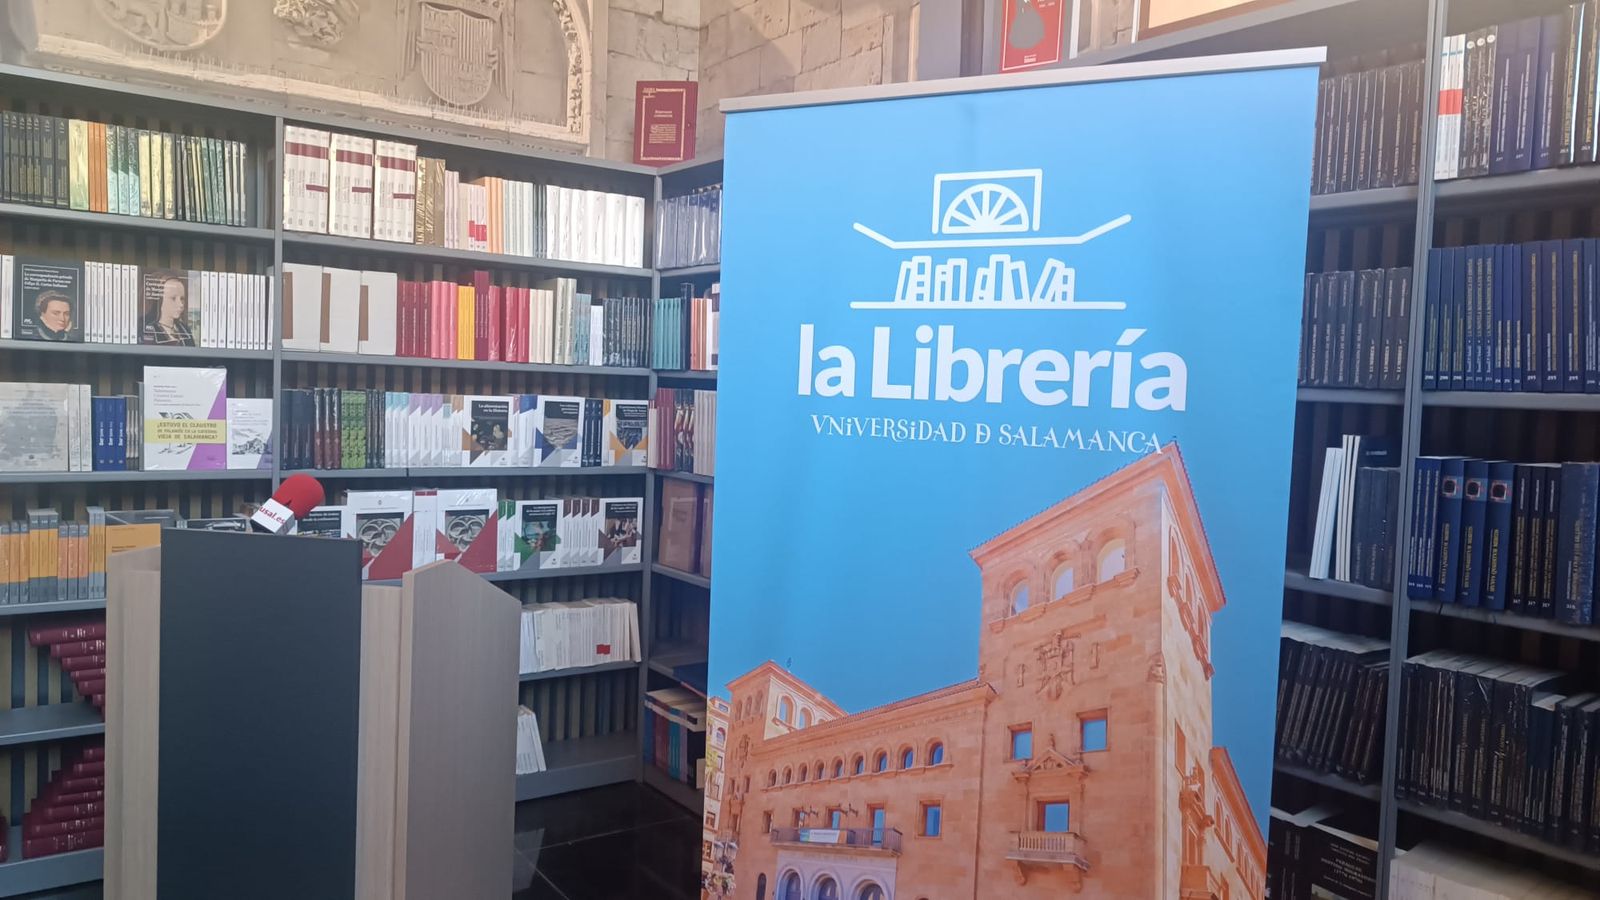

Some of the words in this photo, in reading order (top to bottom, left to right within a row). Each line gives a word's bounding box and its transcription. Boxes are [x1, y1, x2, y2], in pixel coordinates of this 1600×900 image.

[797, 323, 856, 397] la
[871, 324, 1188, 412] Librería
[998, 423, 1163, 455] SALAMANCA
[259, 506, 286, 525] usal.es
